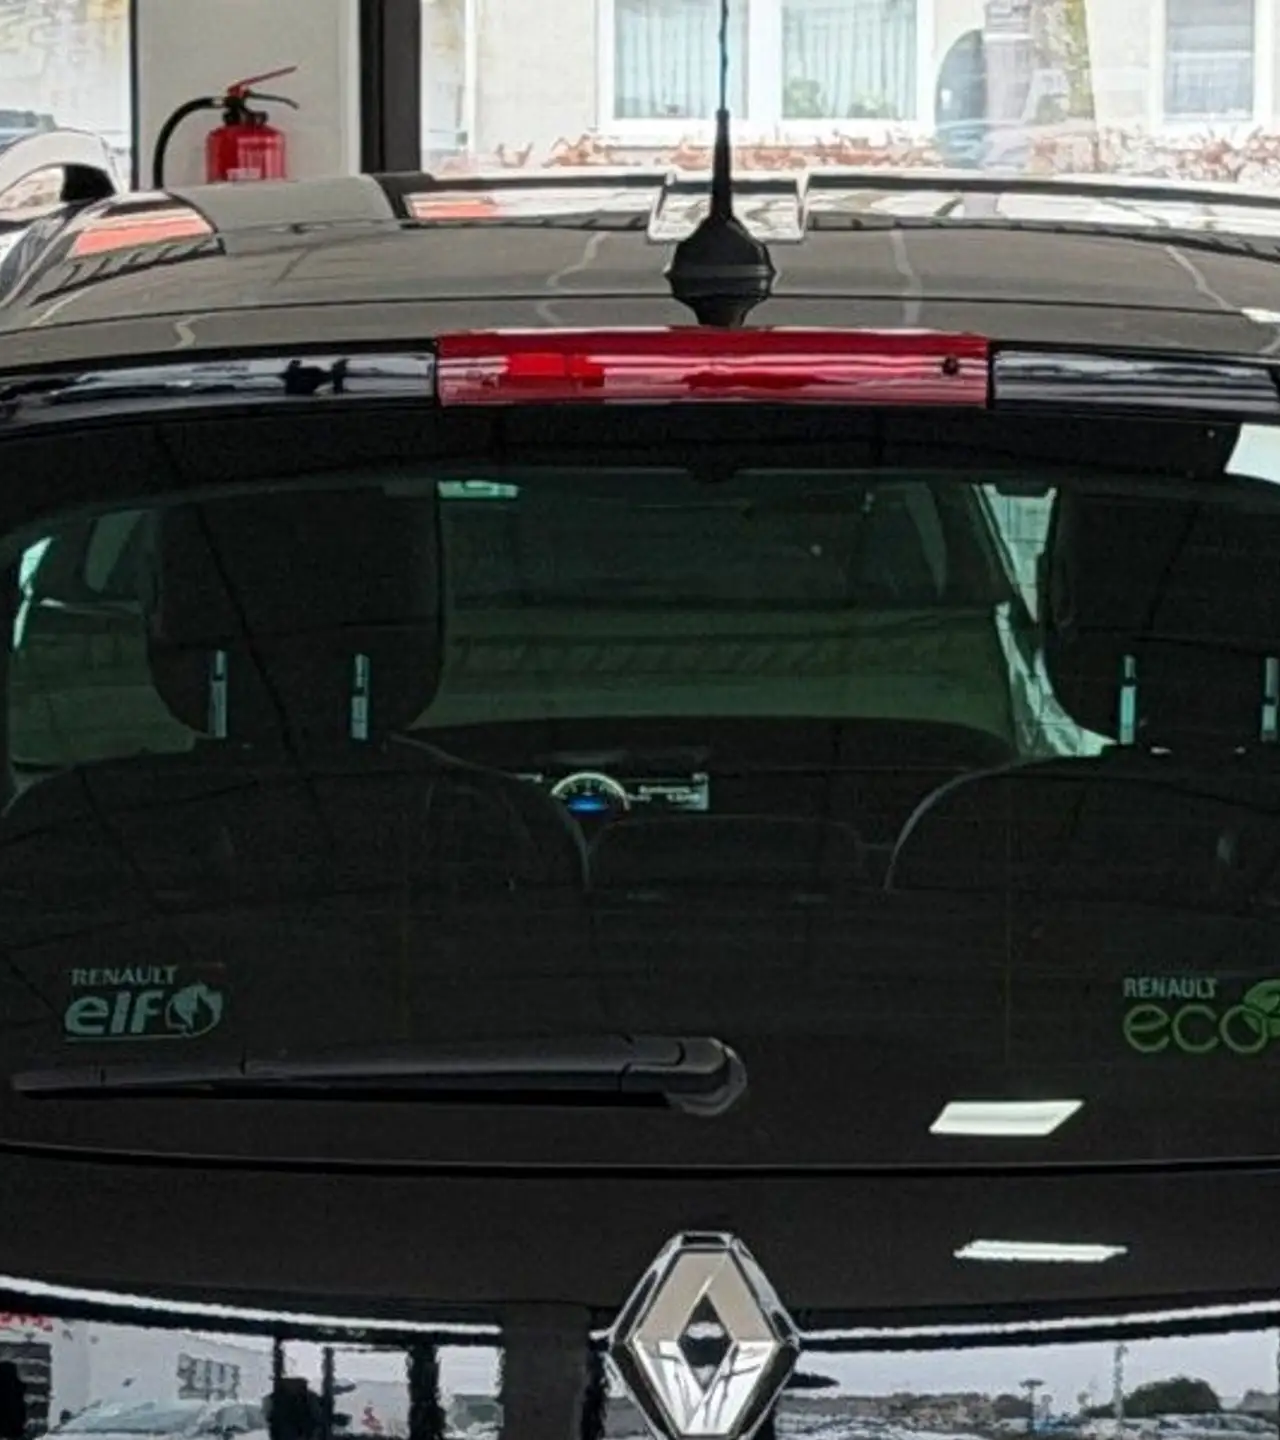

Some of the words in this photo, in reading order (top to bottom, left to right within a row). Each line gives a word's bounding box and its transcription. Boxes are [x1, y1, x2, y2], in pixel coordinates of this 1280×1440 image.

[71, 965, 178, 986] RENAULT
[1123, 977, 1218, 998] RENAULT
[64, 990, 164, 1035] elf
